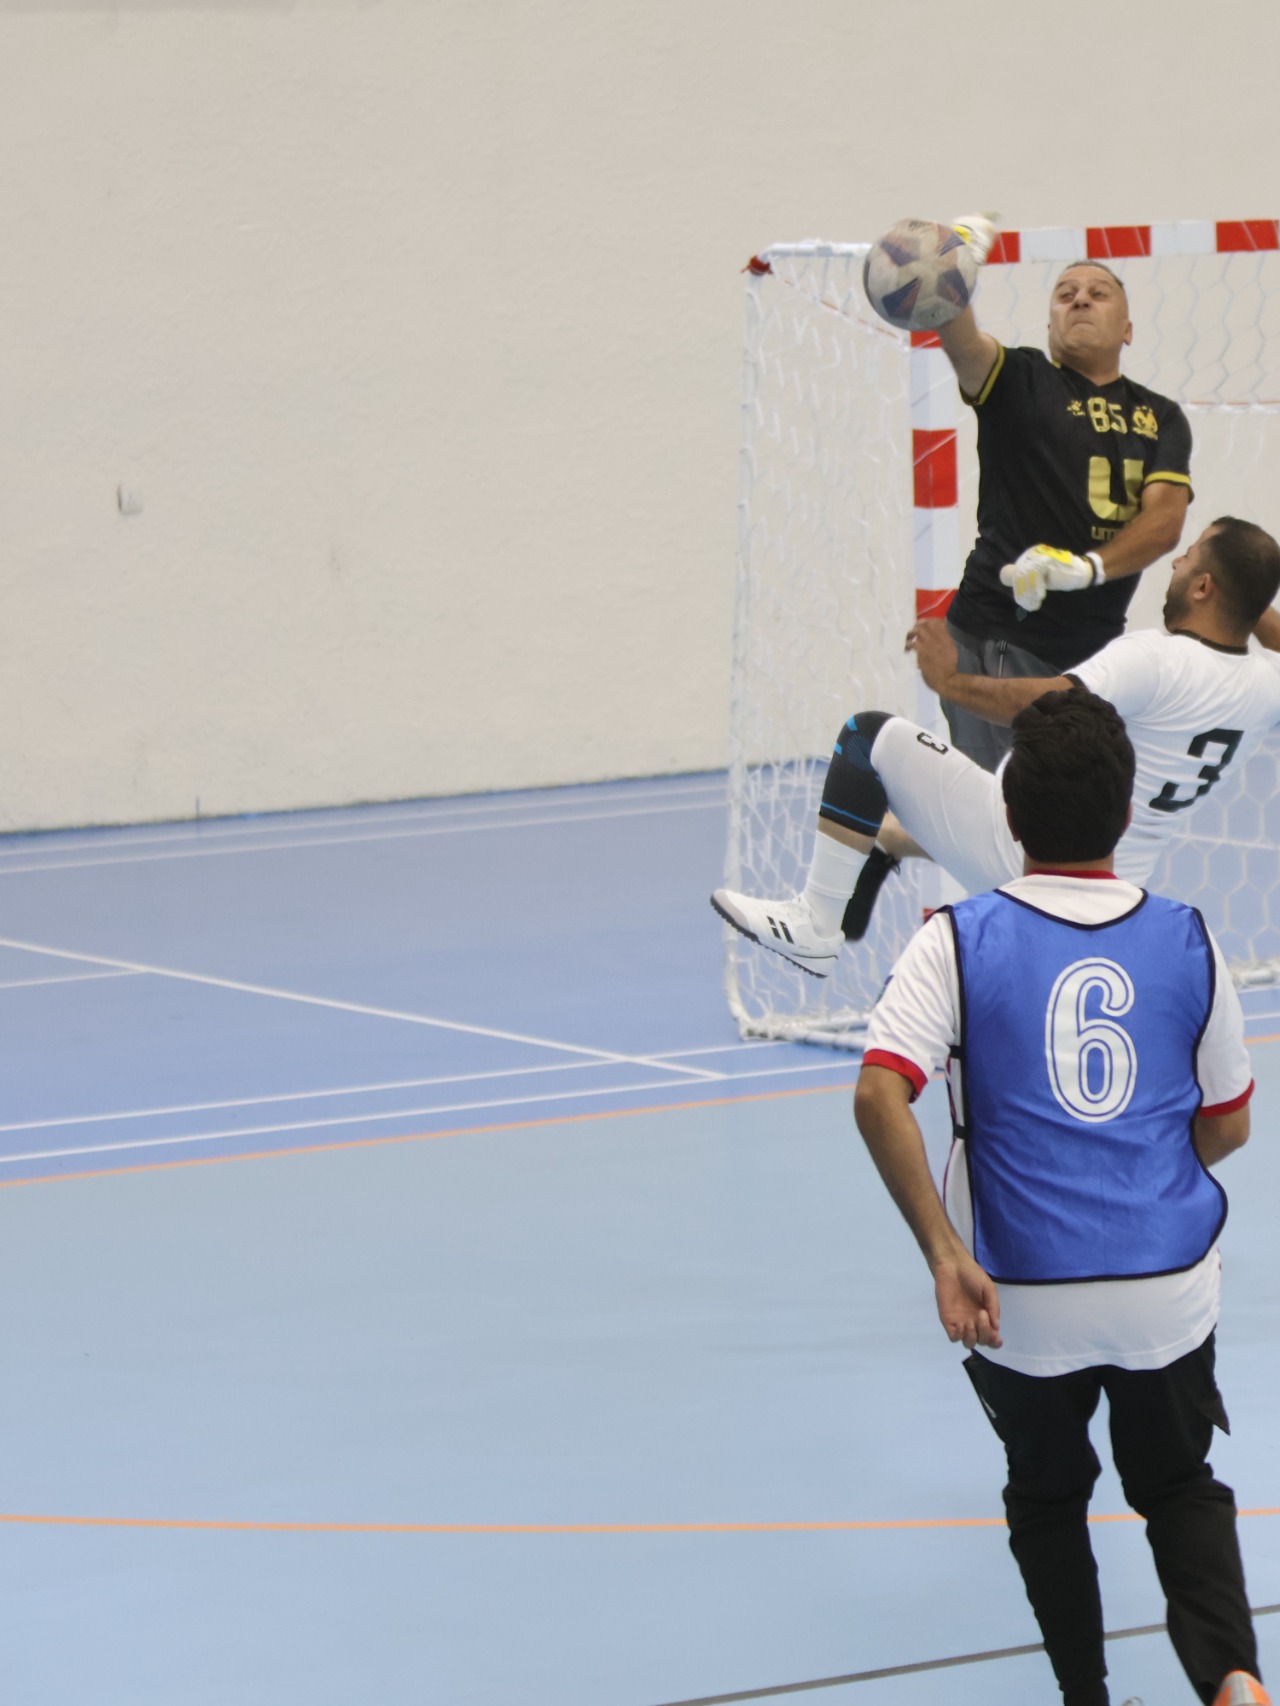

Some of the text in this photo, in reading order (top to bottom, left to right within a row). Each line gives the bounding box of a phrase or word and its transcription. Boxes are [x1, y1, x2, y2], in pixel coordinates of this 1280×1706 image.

[1087, 396, 1128, 434] 85
[916, 732, 949, 755] 3
[1149, 727, 1245, 813] 3
[1045, 957, 1138, 1123] 6
